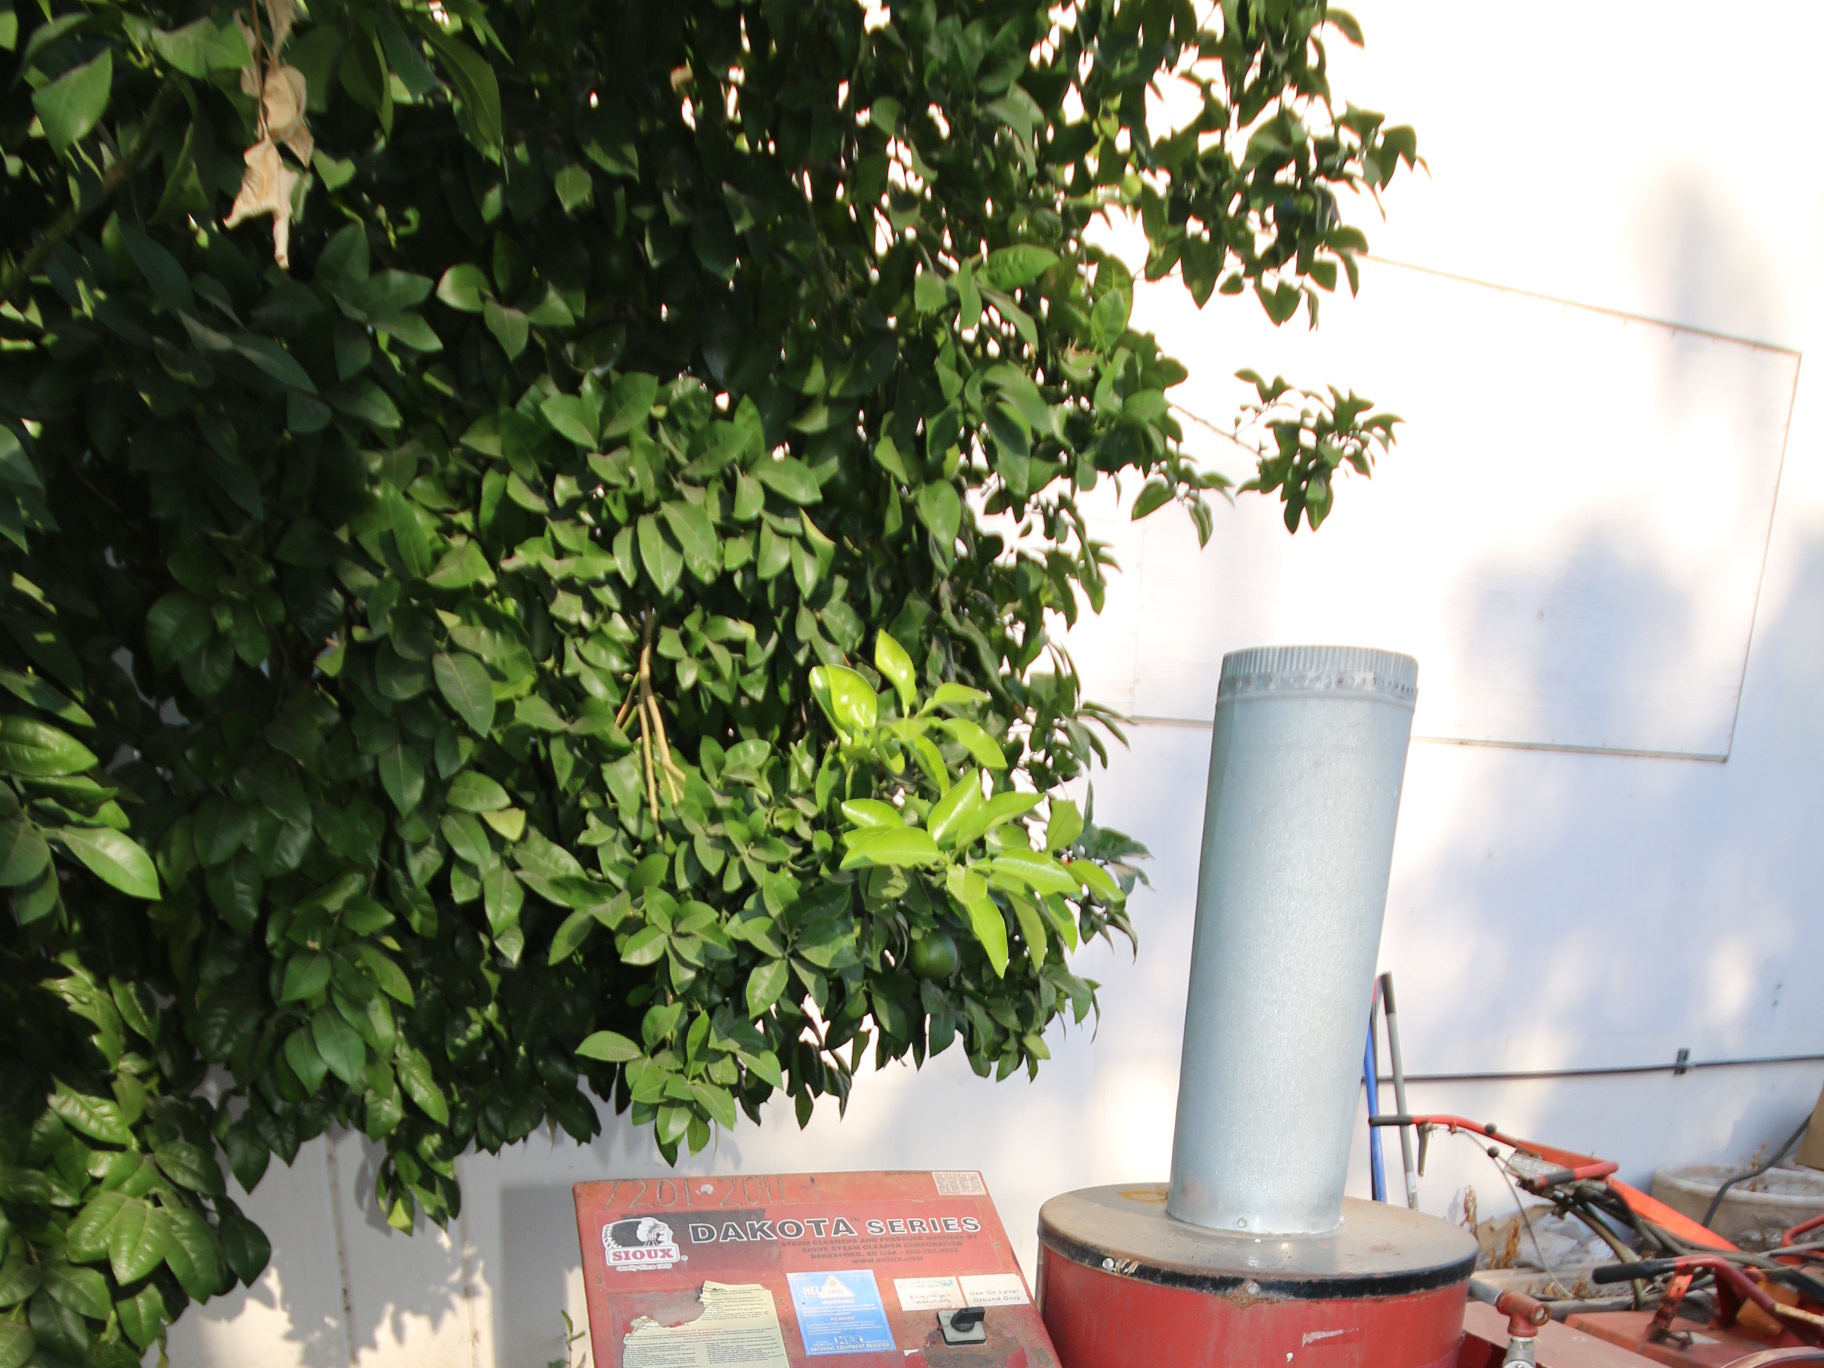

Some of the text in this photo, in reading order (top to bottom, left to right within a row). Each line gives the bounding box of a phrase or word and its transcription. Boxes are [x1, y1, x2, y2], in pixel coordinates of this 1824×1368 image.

[718, 1175, 786, 1207] 2011
[689, 1217, 981, 1243] DAKOTA SERIES
[612, 1248, 674, 1262] SIOUX
